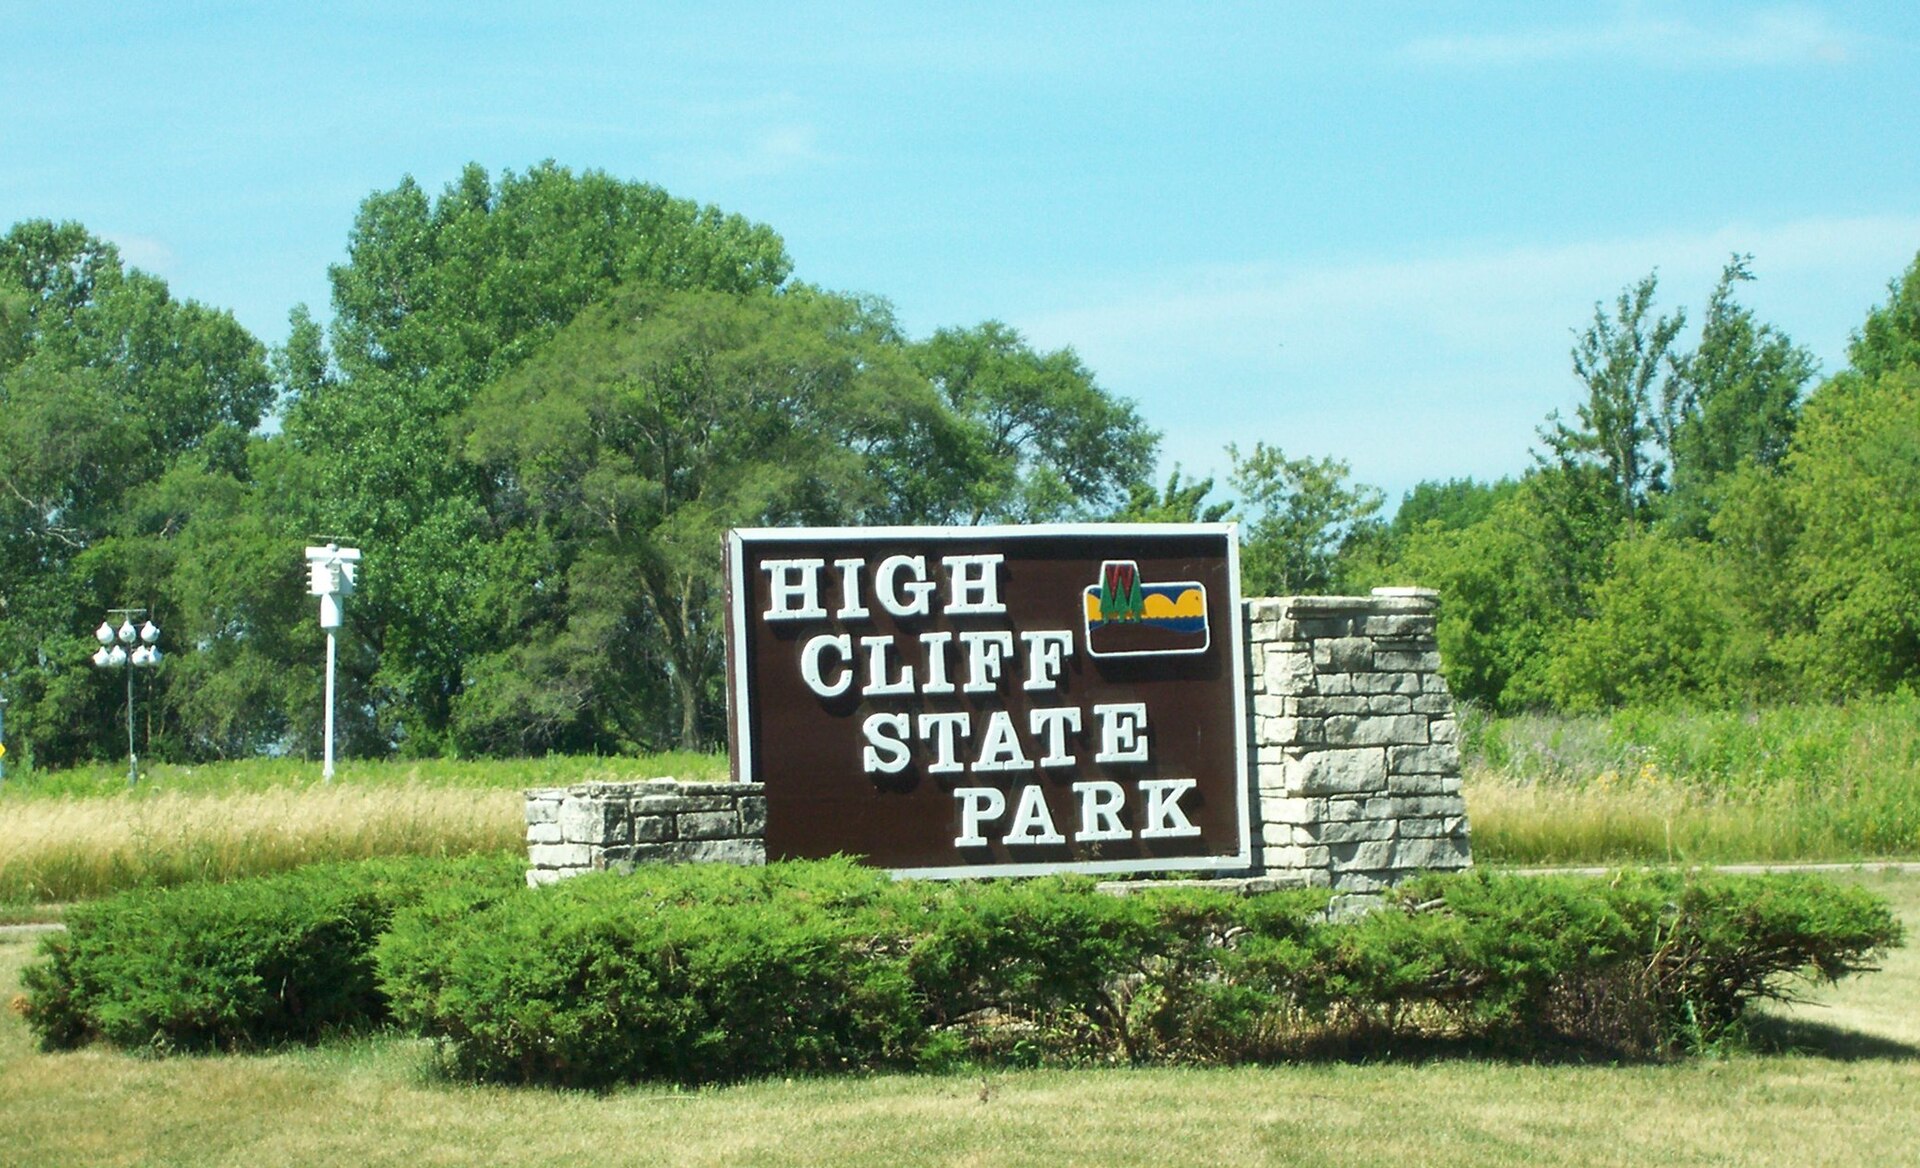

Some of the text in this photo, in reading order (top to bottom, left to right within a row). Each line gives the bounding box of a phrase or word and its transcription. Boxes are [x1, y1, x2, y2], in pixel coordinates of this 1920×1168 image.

[760, 553, 1007, 621] HIGH
[800, 629, 1074, 697] CLIFF
[861, 702, 1149, 774] STATE
[953, 778, 1202, 848] PARK
